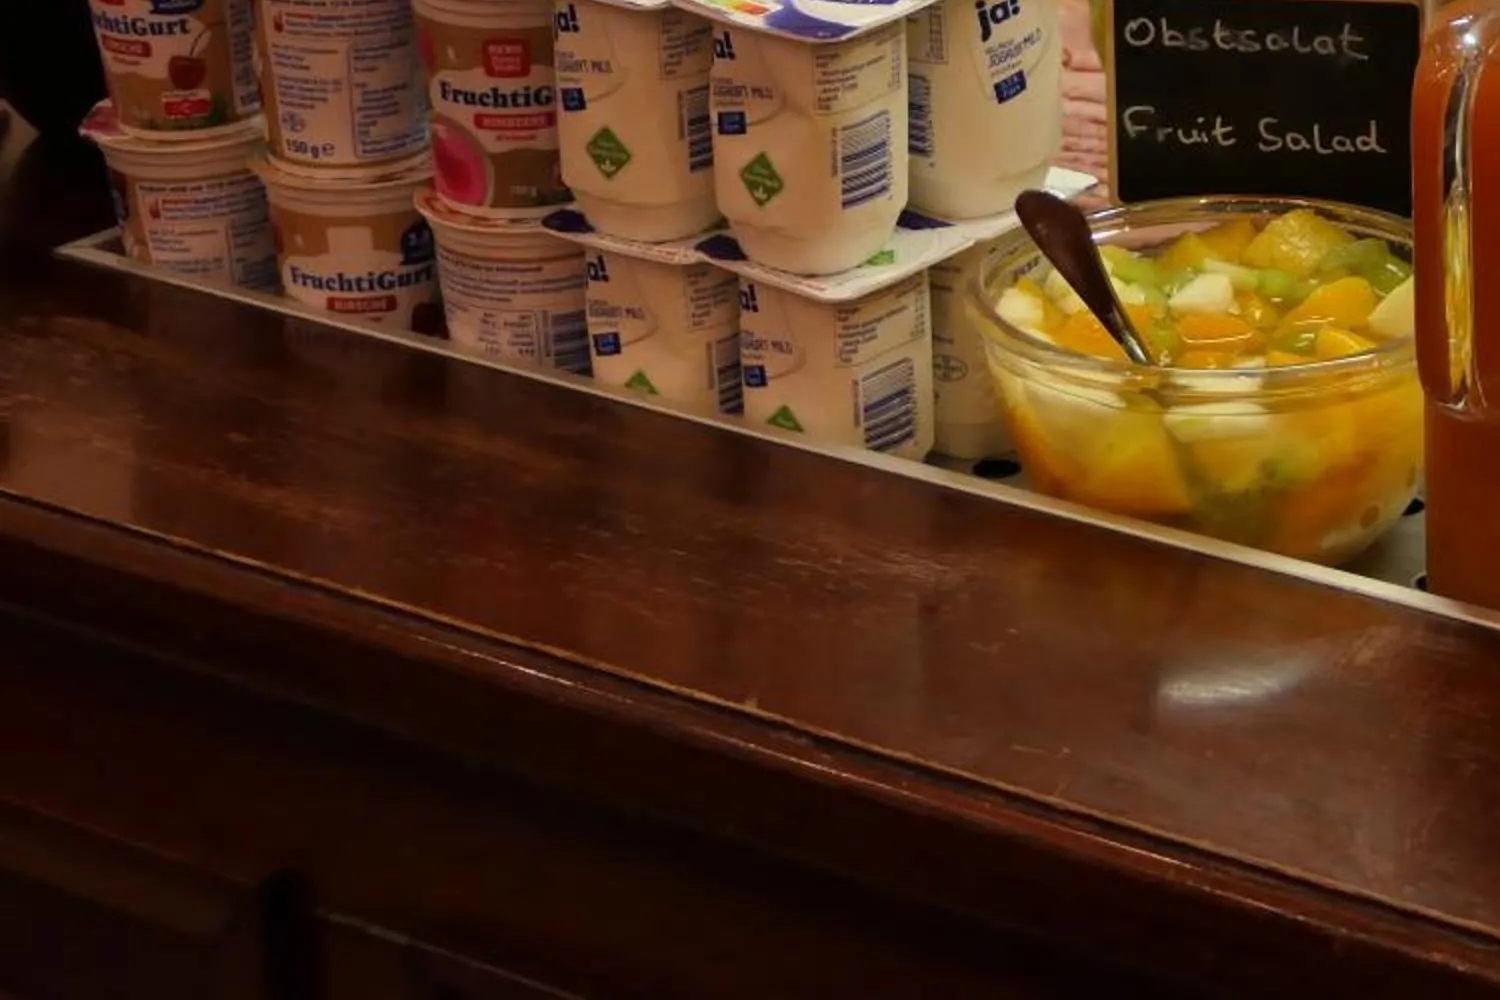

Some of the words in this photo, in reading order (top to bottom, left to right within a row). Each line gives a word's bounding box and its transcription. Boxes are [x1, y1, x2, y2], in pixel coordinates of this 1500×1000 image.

[713, 31, 736, 62] a!
[1124, 16, 1369, 61] Obstsalat
[439, 80, 553, 110] FruchtiG
[1122, 105, 1238, 147] Fruit
[1257, 116, 1388, 155] Salad
